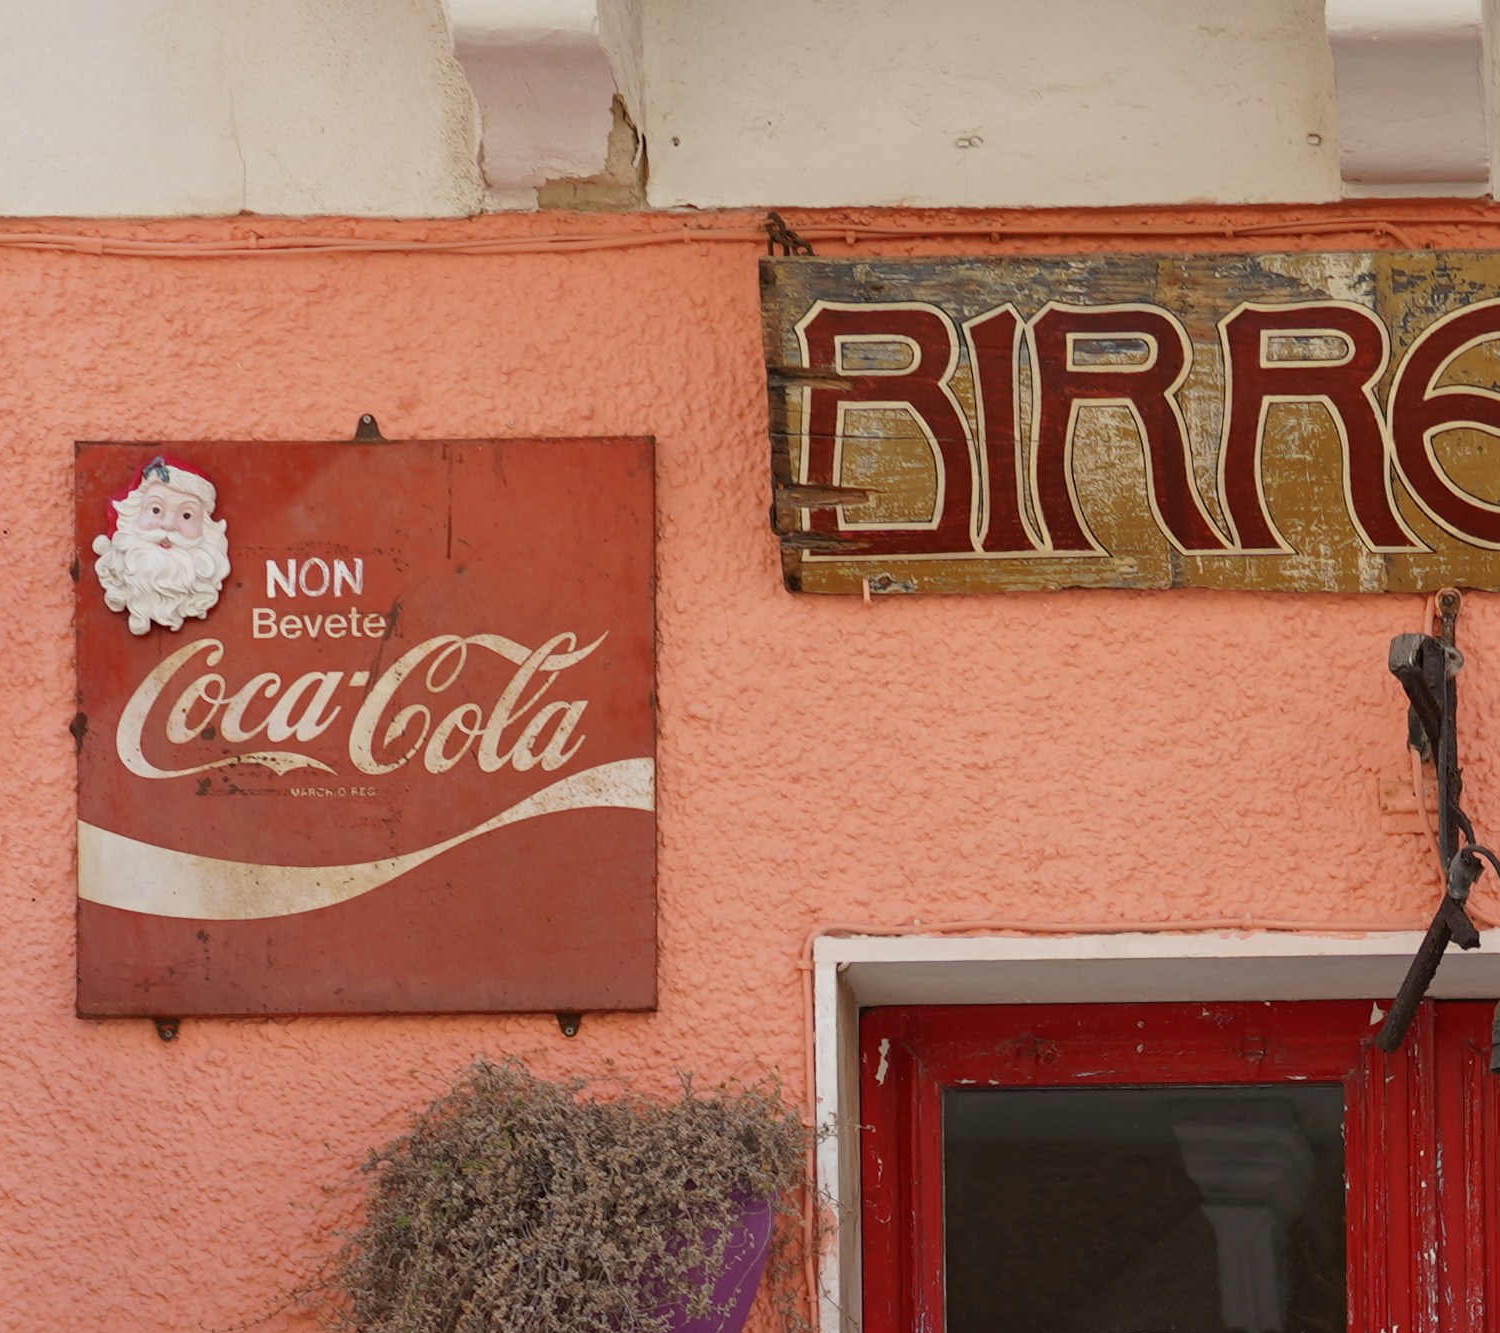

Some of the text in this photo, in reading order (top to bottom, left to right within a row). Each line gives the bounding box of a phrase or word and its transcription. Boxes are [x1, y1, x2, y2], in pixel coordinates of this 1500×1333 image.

[265, 557, 364, 599] NON
[252, 607, 386, 639] Bevete
[116, 630, 609, 779] Coca-Cola
